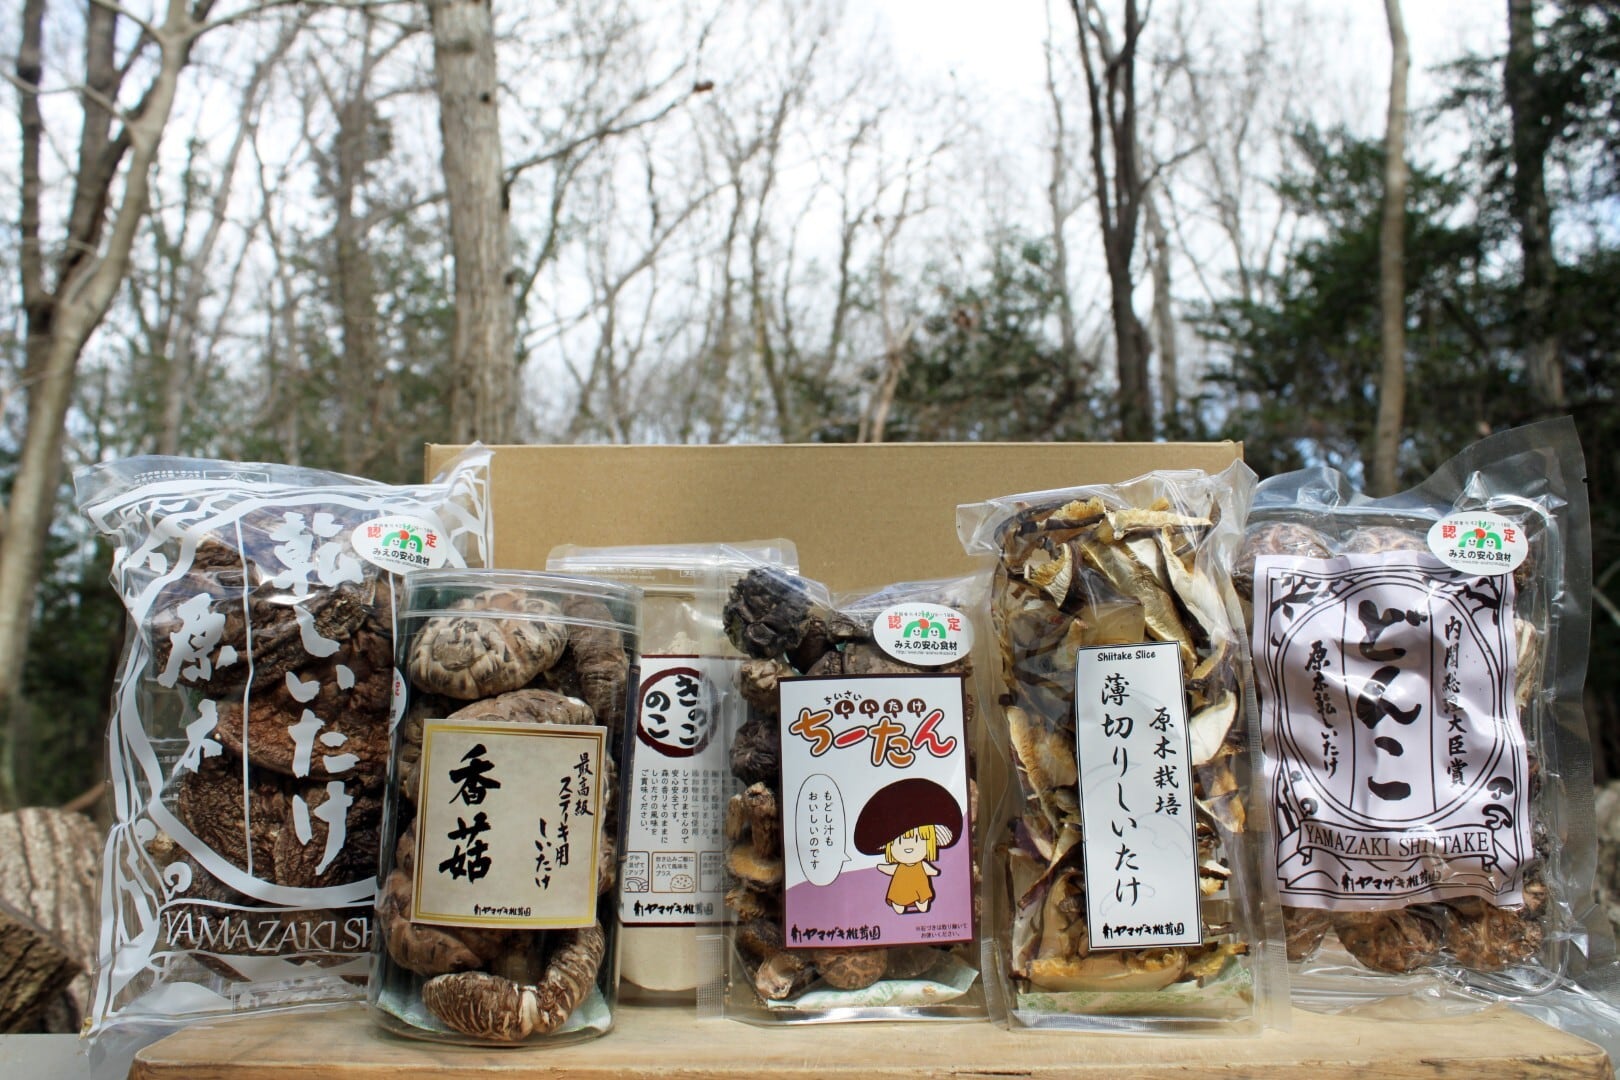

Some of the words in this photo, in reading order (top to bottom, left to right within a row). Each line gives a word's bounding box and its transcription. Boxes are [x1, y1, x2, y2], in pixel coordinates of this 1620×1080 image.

[372, 547, 430, 567] みえの安心食材
[425, 532, 437, 548] 定
[1442, 525, 1457, 539] 認
[1503, 529, 1516, 543] 定
[1448, 549, 1512, 562] みえの安心食材
[888, 615, 902, 630] 認
[947, 618, 962, 632] 定
[894, 640, 958, 651] みえの安心食材
[1097, 652, 1133, 662] Shiitake
[1135, 650, 1157, 660] Slice
[824, 690, 862, 705] ちいさい
[840, 700, 923, 713] しいたけ
[1356, 599, 1428, 801] どんこ
[789, 707, 957, 768] ちーたん
[1148, 706, 1182, 816] 原木栽培
[573, 752, 594, 816] 最高級
[640, 769, 649, 832] ご賞味ください。
[650, 769, 659, 836] しいたけの風味を
[660, 769, 669, 844] 森の香りそのままに
[671, 769, 680, 823] 安心安全です。
[681, 769, 689, 844] しておりませんので
[1101, 672, 1141, 907] 薄切りしいたけ
[555, 776, 573, 868] ステーキ用
[808, 791, 820, 870] おいしいのです
[824, 790, 835, 847] もどし汁も
[1305, 825, 1391, 857] YAMAZAKI
[1399, 832, 1490, 857] SHIITAKE
[535, 817, 552, 890] しいたけ
[163, 911, 336, 952] YAMAZAKI
